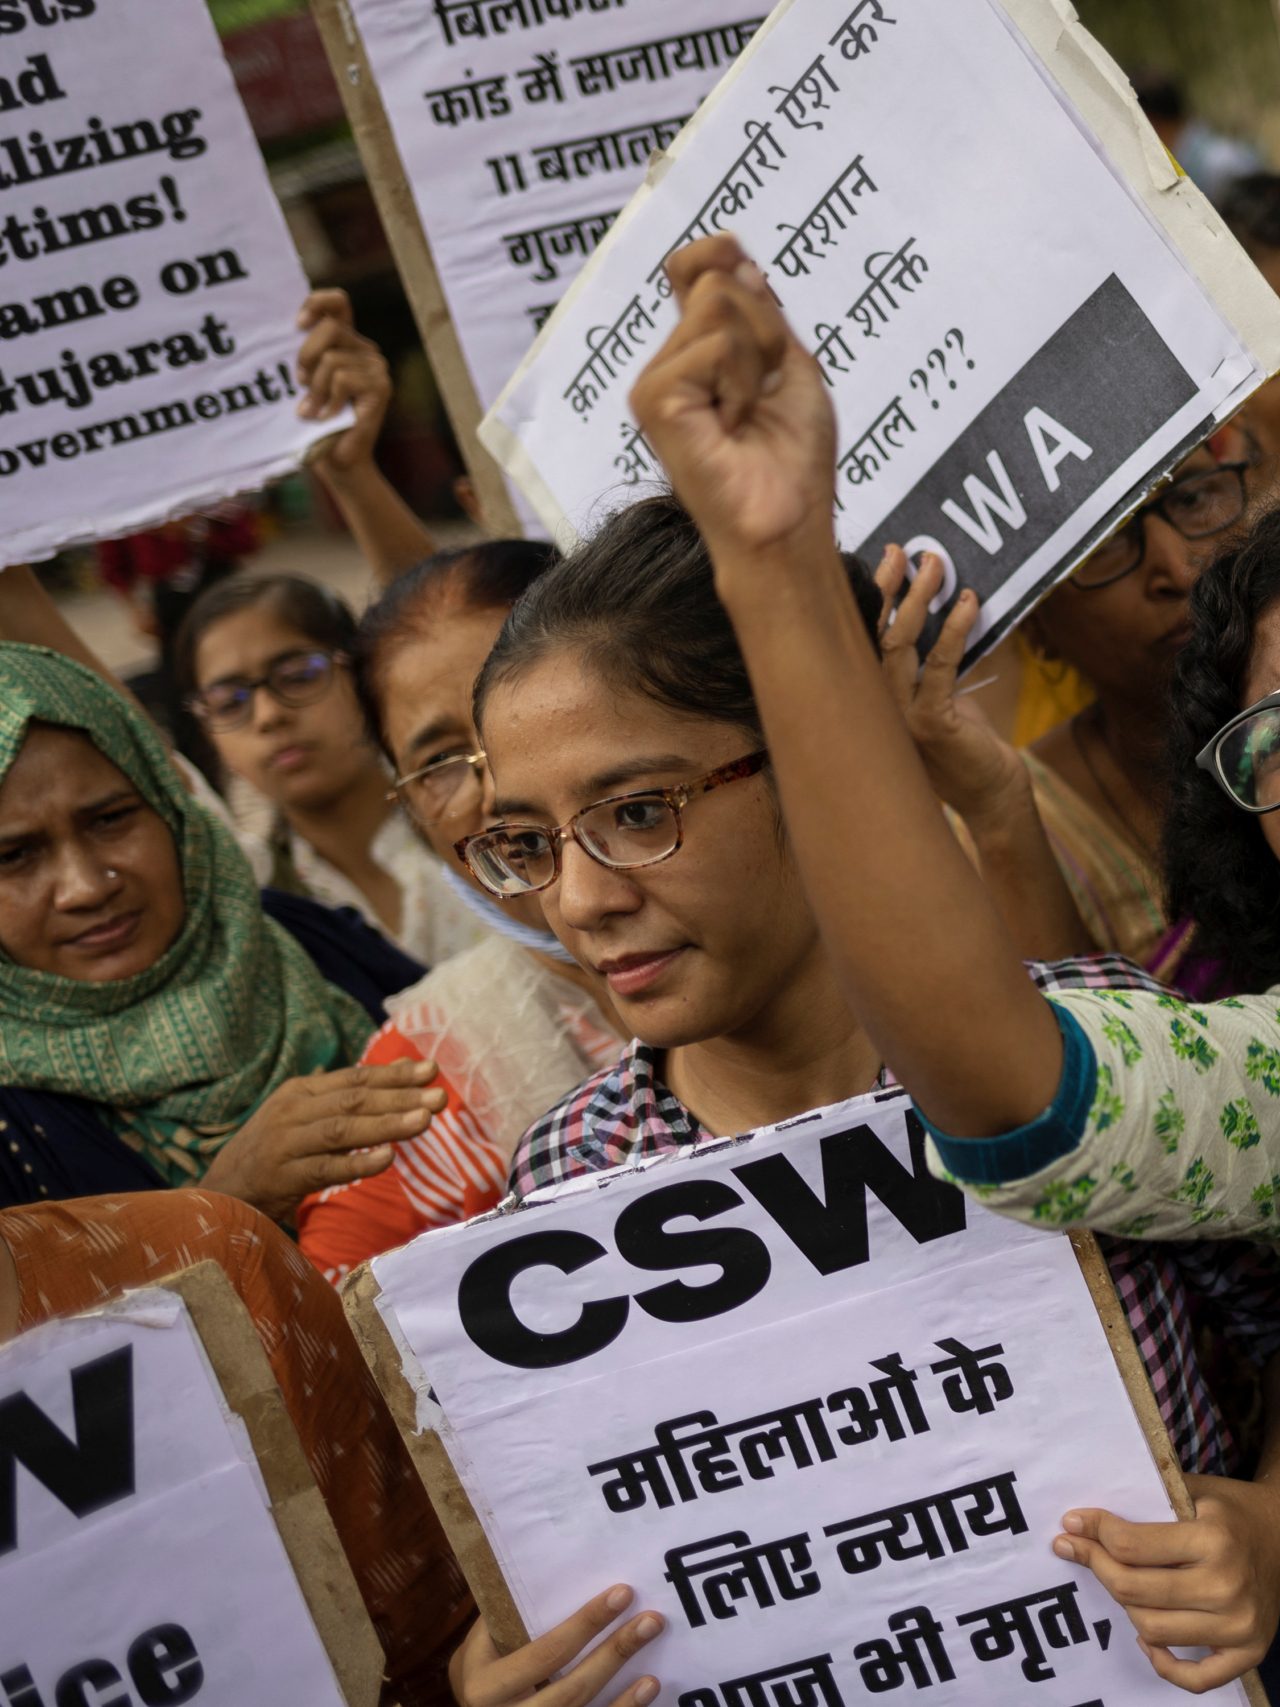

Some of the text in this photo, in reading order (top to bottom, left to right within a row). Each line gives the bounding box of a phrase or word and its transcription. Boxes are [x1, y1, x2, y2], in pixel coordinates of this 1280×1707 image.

[424, 69, 512, 126] कांड
[517, 50, 566, 104] में
[768, 55, 840, 130] ऐश
[0, 109, 206, 189] lizing
[488, 153, 530, 195] 11
[772, 155, 879, 278] परेशान
[162, 246, 248, 298] on
[846, 237, 929, 339] शक्ति
[836, 327, 976, 486] काल ???
[457, 1109, 967, 1369] CSW
[929, 1337, 1014, 1416] के
[663, 1471, 1029, 1628] लिए न्याय
[853, 1605, 956, 1693] भी
[956, 1581, 1112, 1683] मृत,
